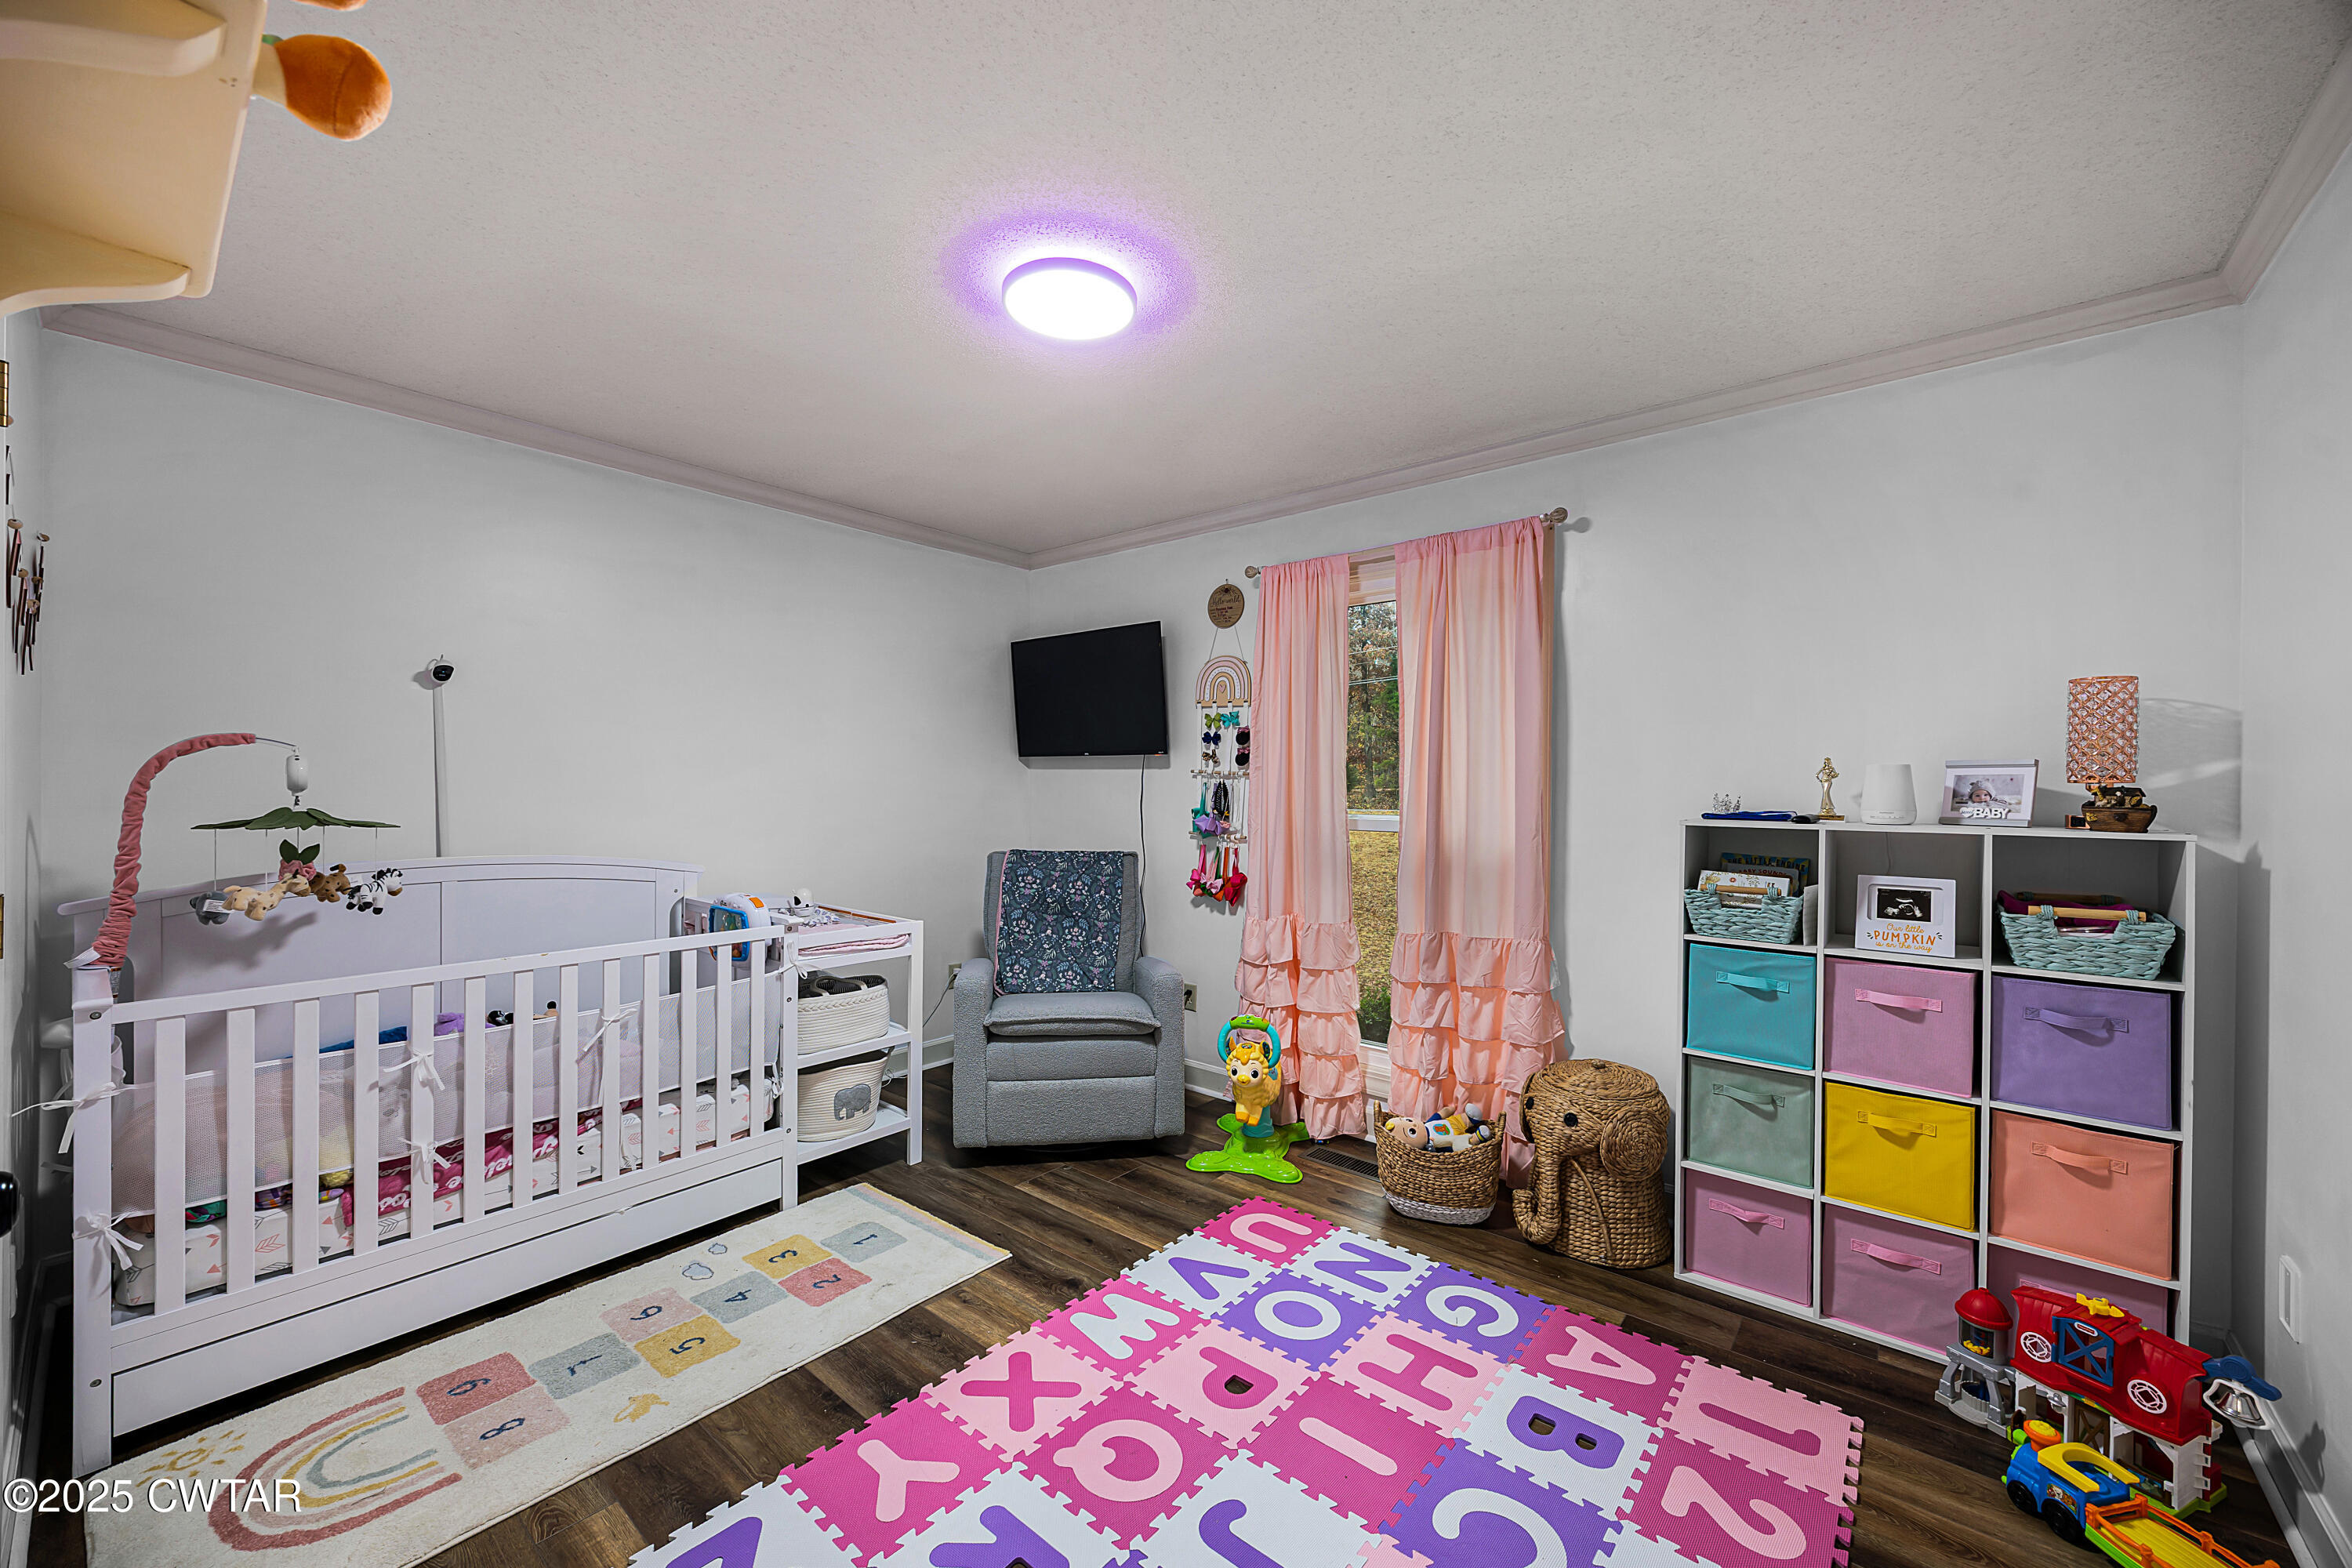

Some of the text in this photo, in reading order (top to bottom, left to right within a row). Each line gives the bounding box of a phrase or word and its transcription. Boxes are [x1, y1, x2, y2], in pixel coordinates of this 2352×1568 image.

[1973, 808, 2009, 819] BABY
[1874, 930, 1936, 946] PUMPKIN
[1886, 923, 1925, 934] Our little
[1898, 941, 1912, 949] the
[1914, 945, 1933, 953] way
[768, 1249, 798, 1263] 3
[813, 1274, 842, 1289] 2
[724, 1289, 752, 1303] 4
[630, 1305, 663, 1320] 6
[1254, 1290, 1342, 1341] O
[1426, 1286, 1519, 1338] G
[670, 1336, 706, 1356] 5
[1546, 1326, 1657, 1385] A
[1200, 1347, 1279, 1410] P
[1358, 1334, 1479, 1411] H
[446, 1377, 492, 1396] 9
[960, 1352, 1082, 1432] X
[479, 1417, 526, 1441] 8
[1507, 1396, 1625, 1470] B
[1053, 1418, 1183, 1501] Q
[857, 1439, 960, 1523] Y
[1661, 1465, 1807, 1559] 2
